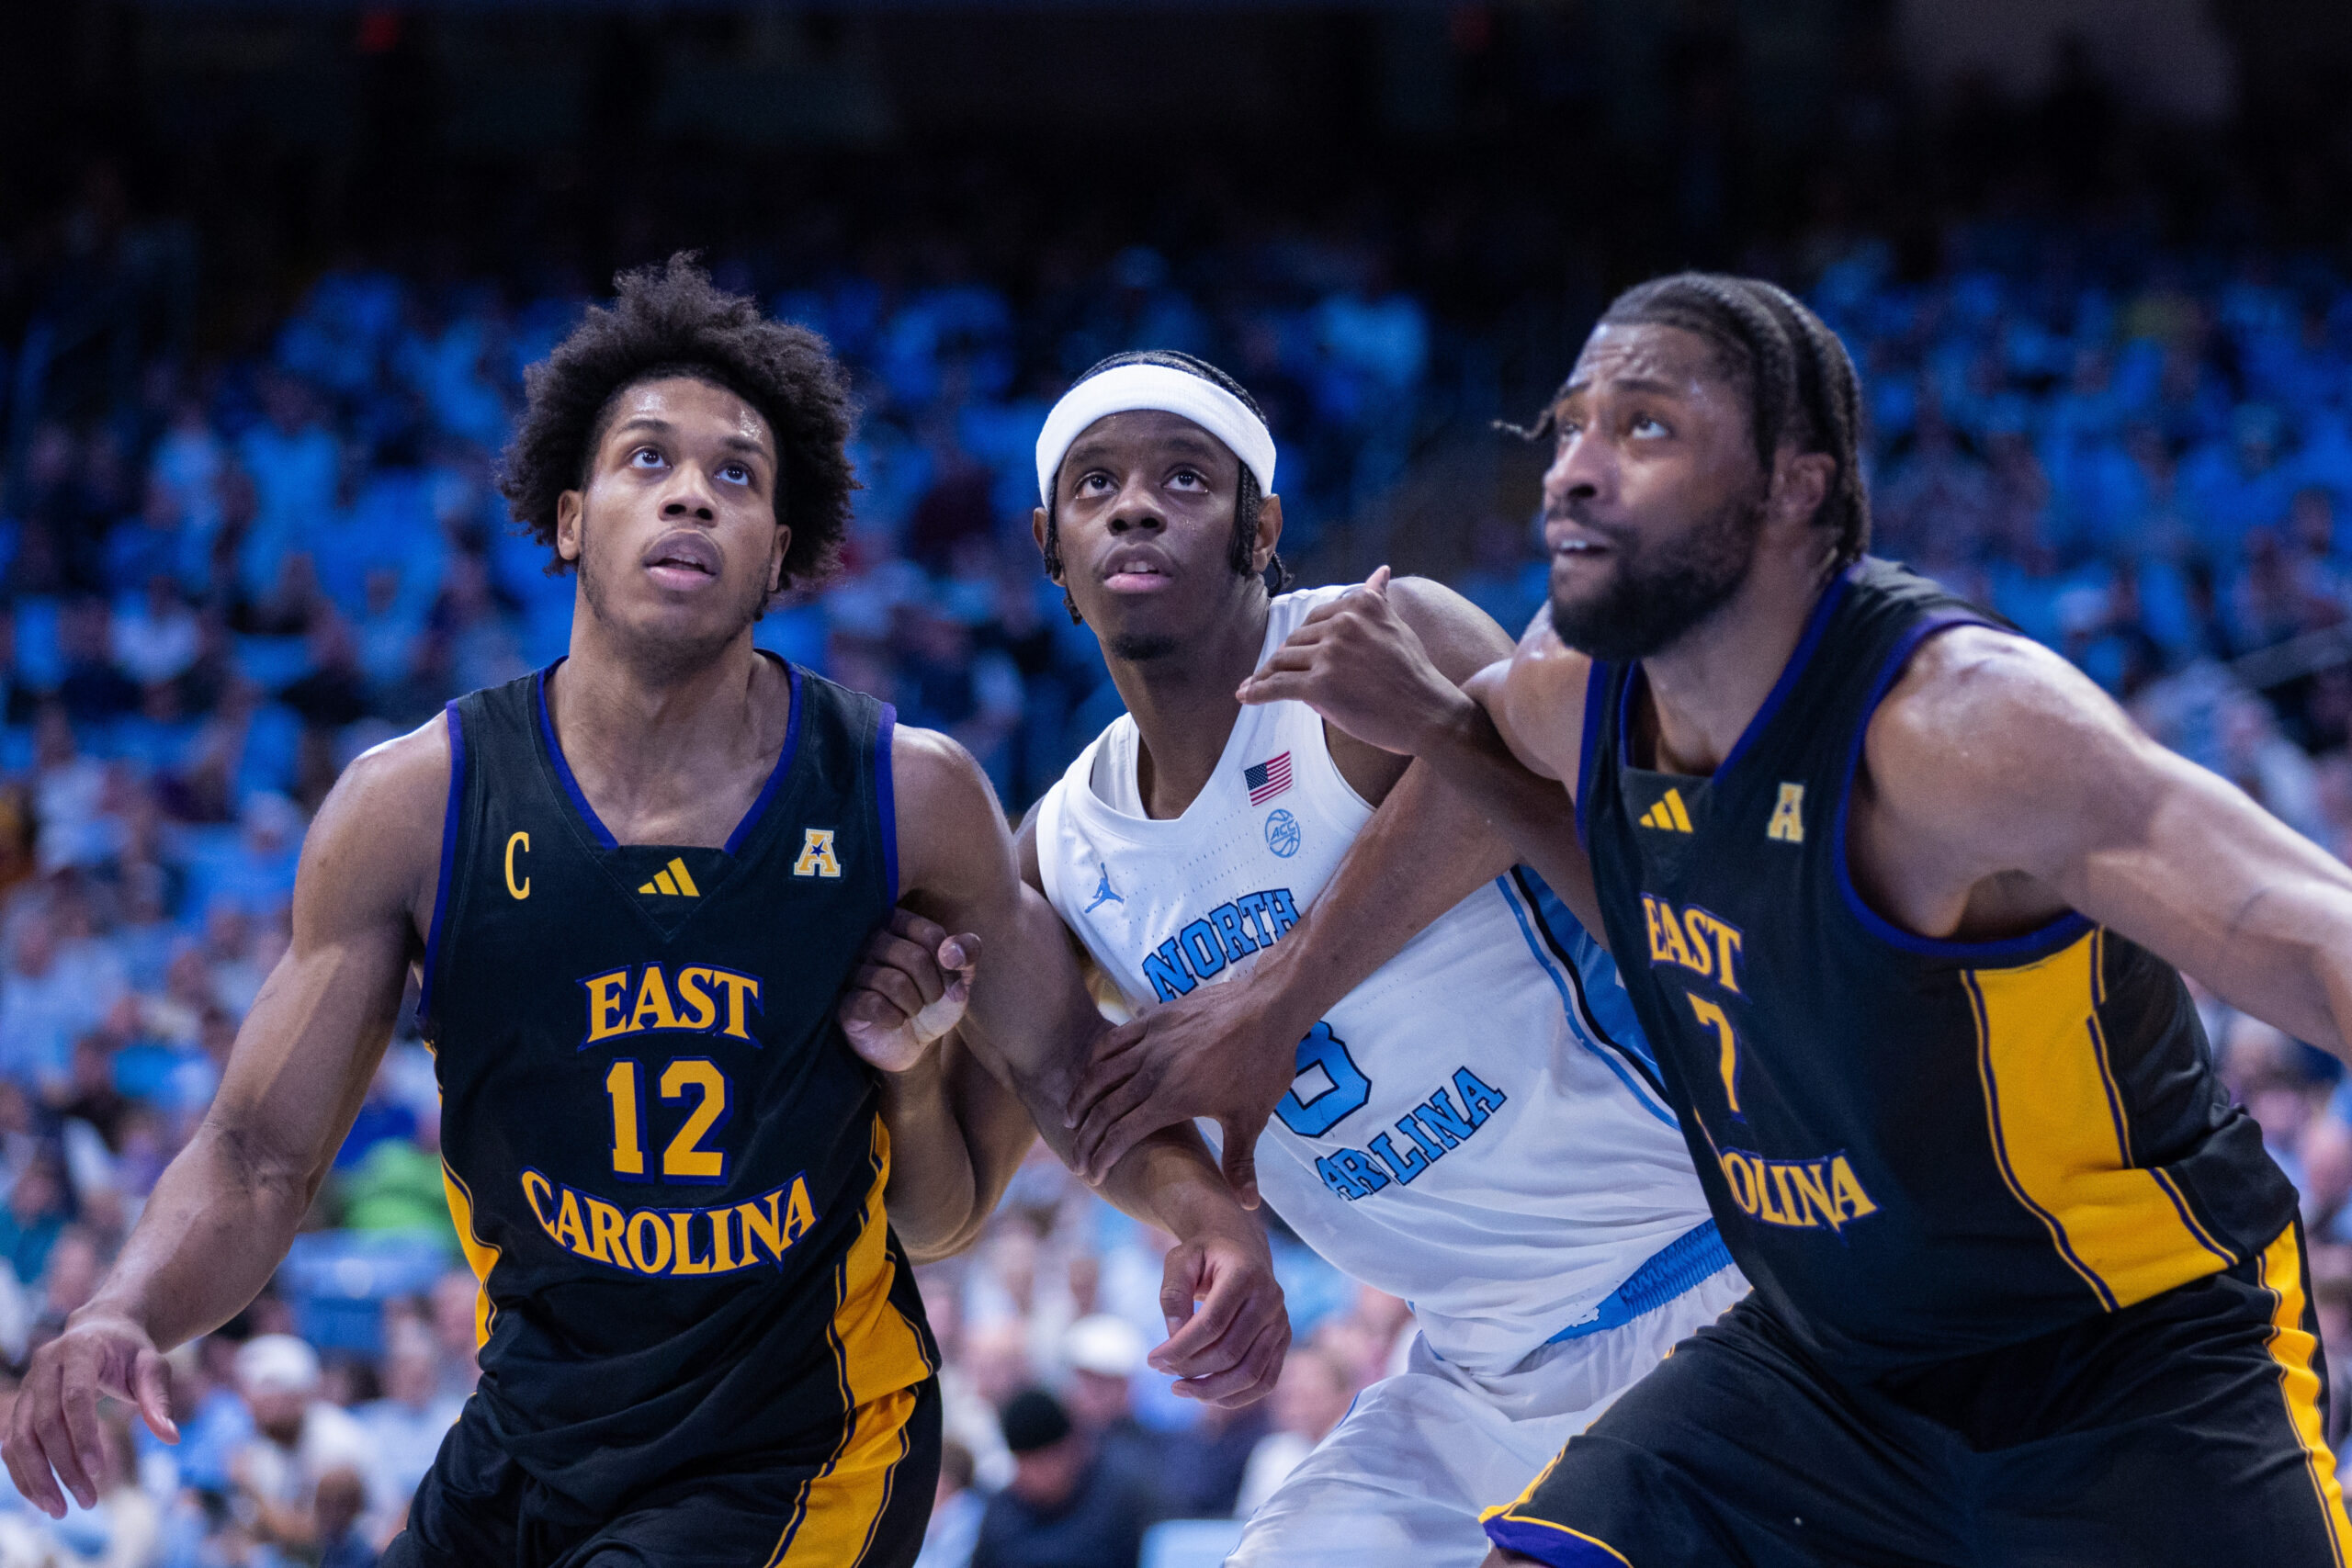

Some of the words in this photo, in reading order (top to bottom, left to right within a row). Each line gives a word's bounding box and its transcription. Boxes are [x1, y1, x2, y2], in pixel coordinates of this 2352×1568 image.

[504, 831, 530, 899] C
[794, 829, 841, 877] A
[1142, 888, 1302, 1004] NORTH
[1641, 892, 1749, 1003] EAST
[577, 962, 763, 1050] EAST
[1685, 990, 1744, 1120] 7
[603, 1056, 734, 1185] 12
[1315, 1066, 1507, 1201] ARLINA
[520, 1166, 821, 1278] CAROLINA
[1720, 1148, 1882, 1237] OLINA
